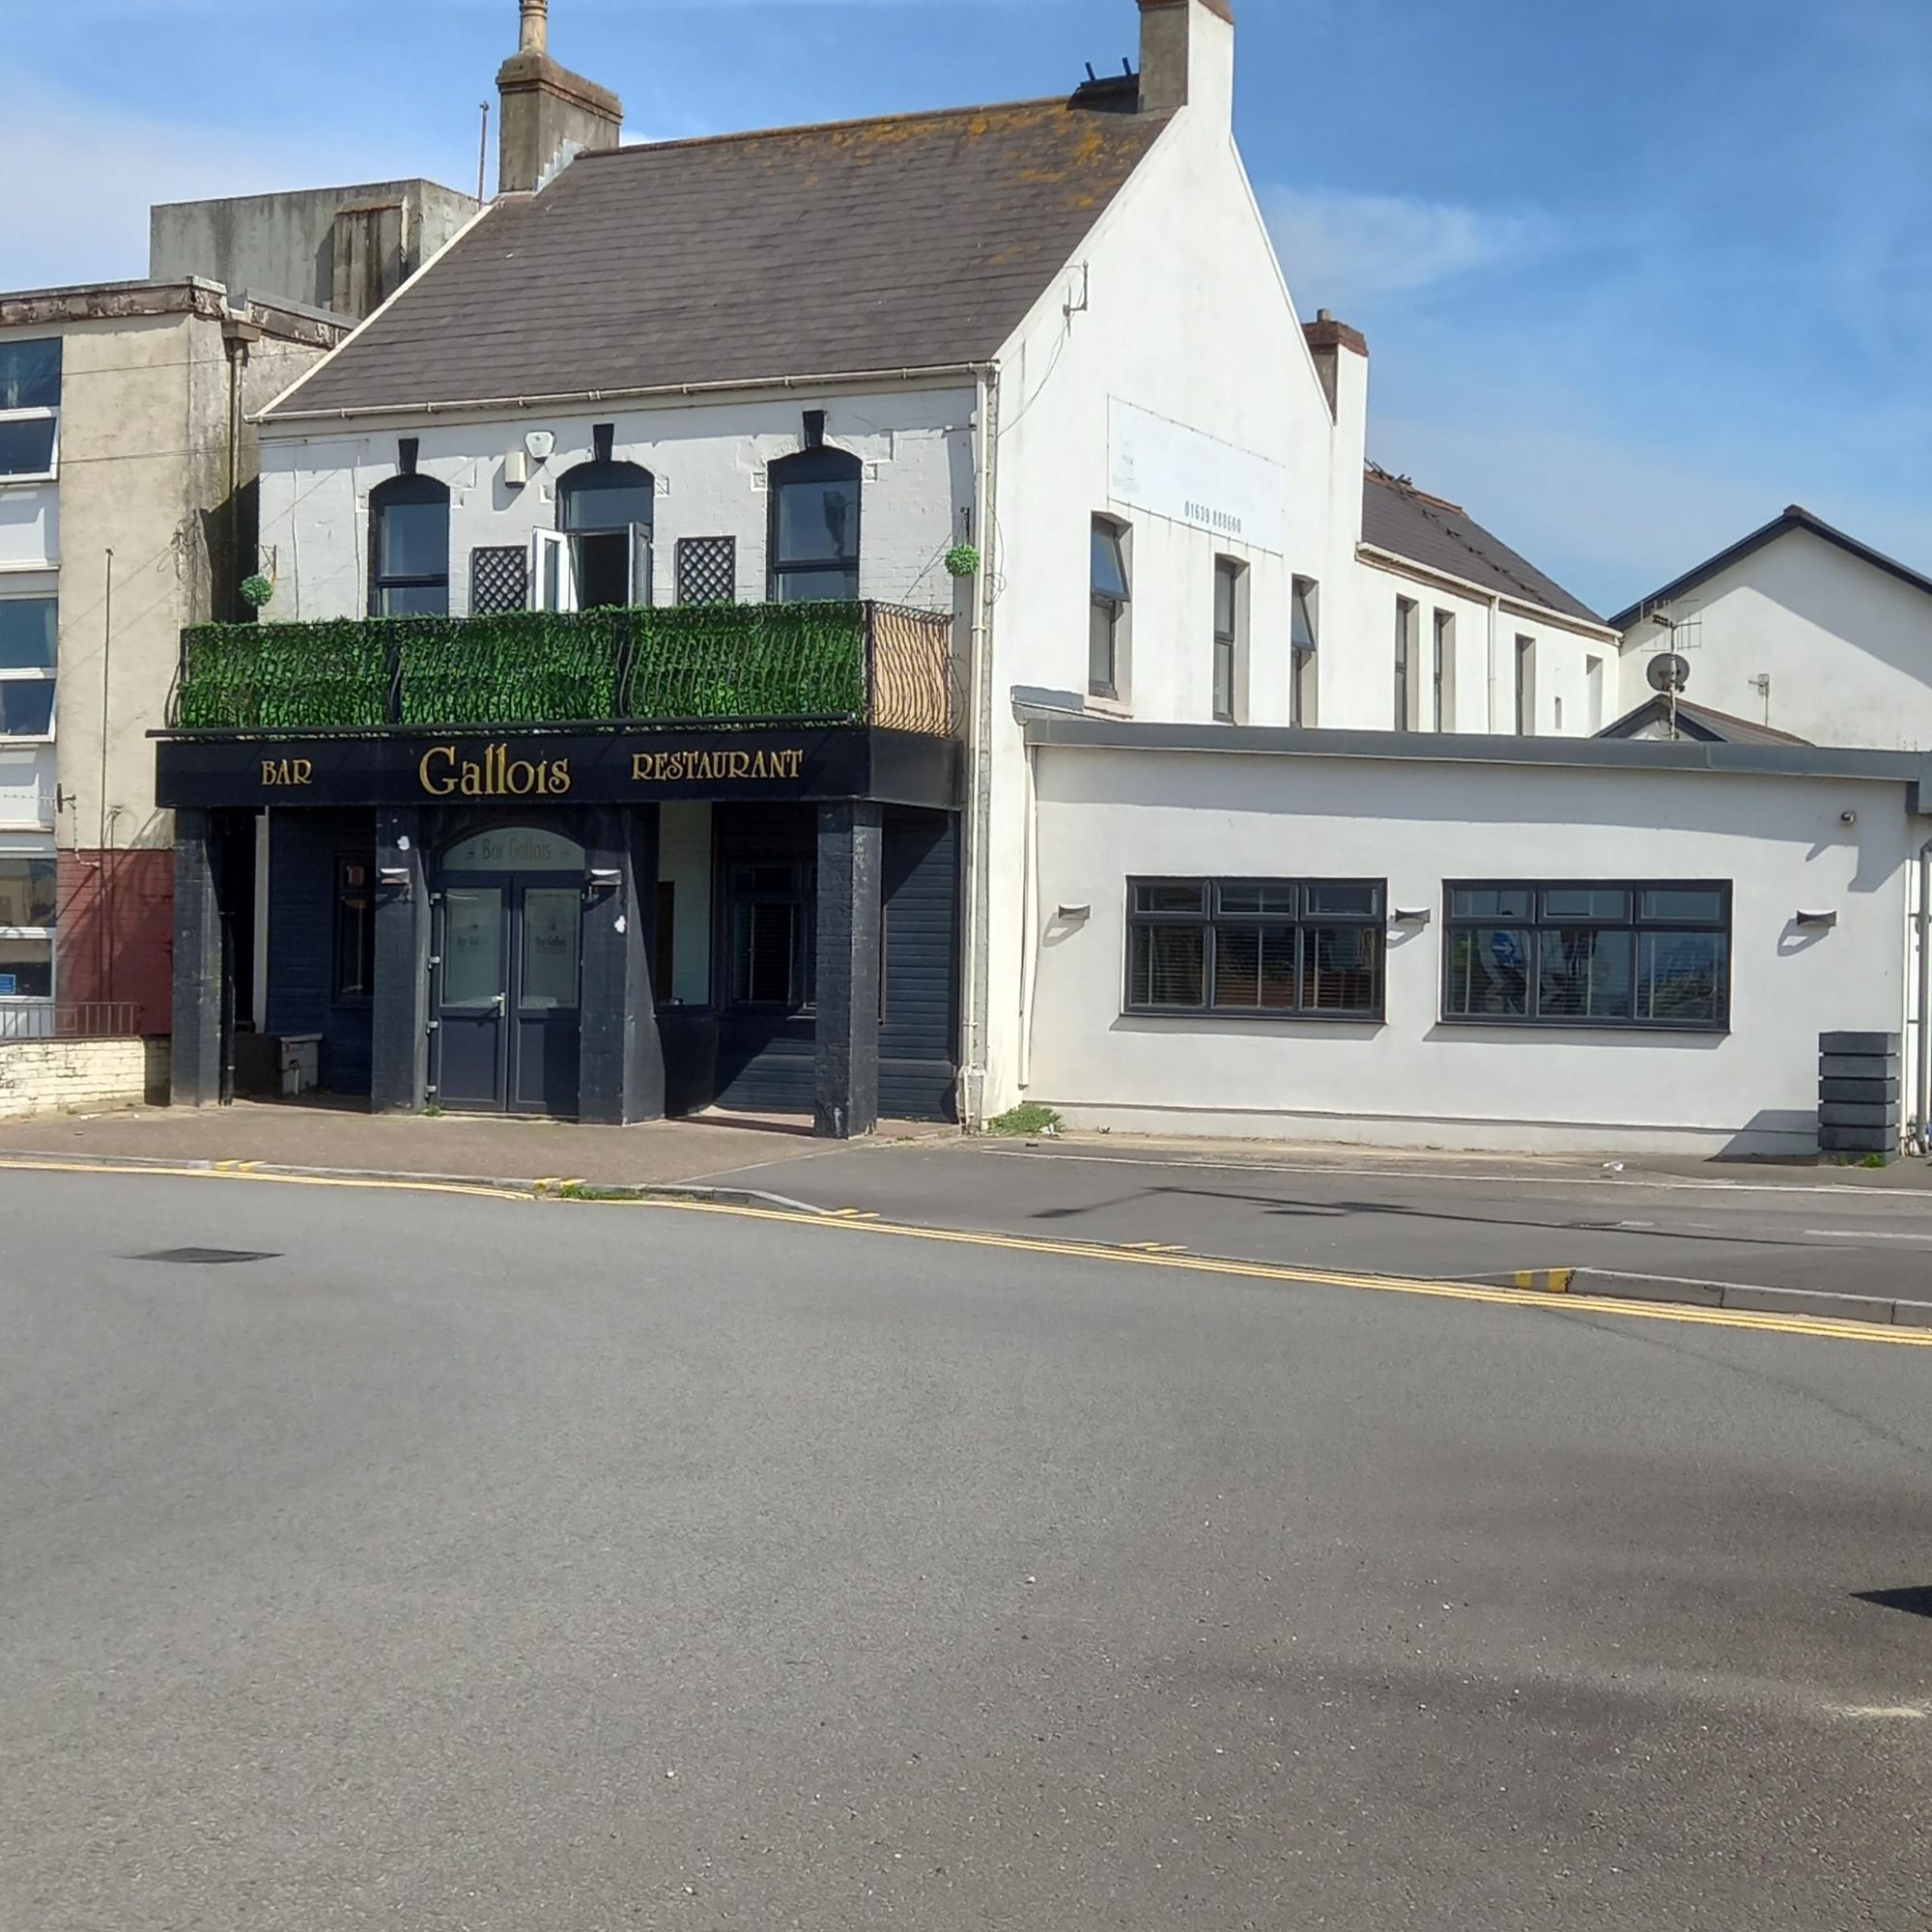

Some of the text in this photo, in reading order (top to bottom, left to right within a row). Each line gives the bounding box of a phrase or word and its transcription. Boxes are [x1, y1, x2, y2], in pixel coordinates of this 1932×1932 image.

[261, 758, 313, 786] BAR
[419, 742, 571, 795] Gallois
[631, 749, 804, 781] RESTAURANT
[482, 835, 552, 861] Bar Gallois
